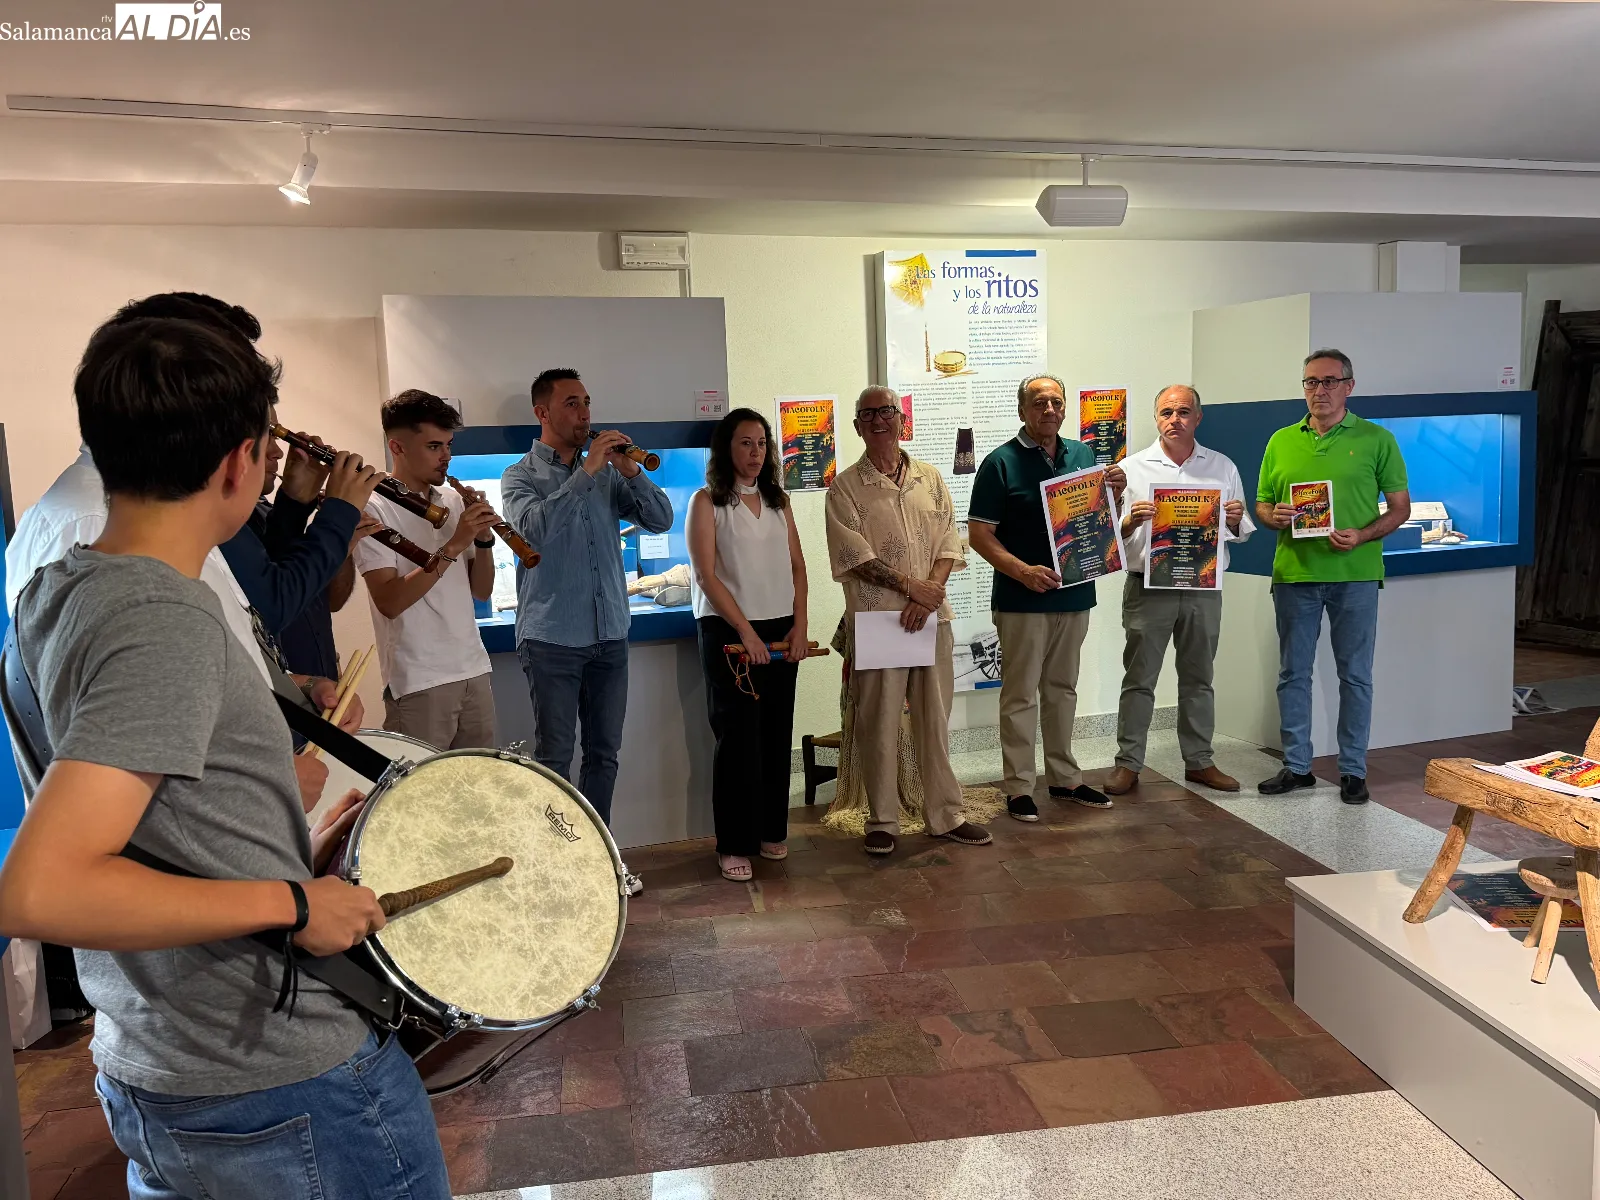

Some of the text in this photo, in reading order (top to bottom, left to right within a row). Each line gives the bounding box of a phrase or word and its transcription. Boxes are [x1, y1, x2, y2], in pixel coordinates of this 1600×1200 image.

[916, 261, 995, 279] Las formas
[952, 272, 1039, 302] y los ritos
[968, 301, 1037, 315] de la naturaleza
[780, 404, 826, 414] MACOFOLK
[1047, 479, 1096, 499] MACOFOLK
[1157, 495, 1210, 503] MACOFOLK
[548, 812, 573, 839] REMO
